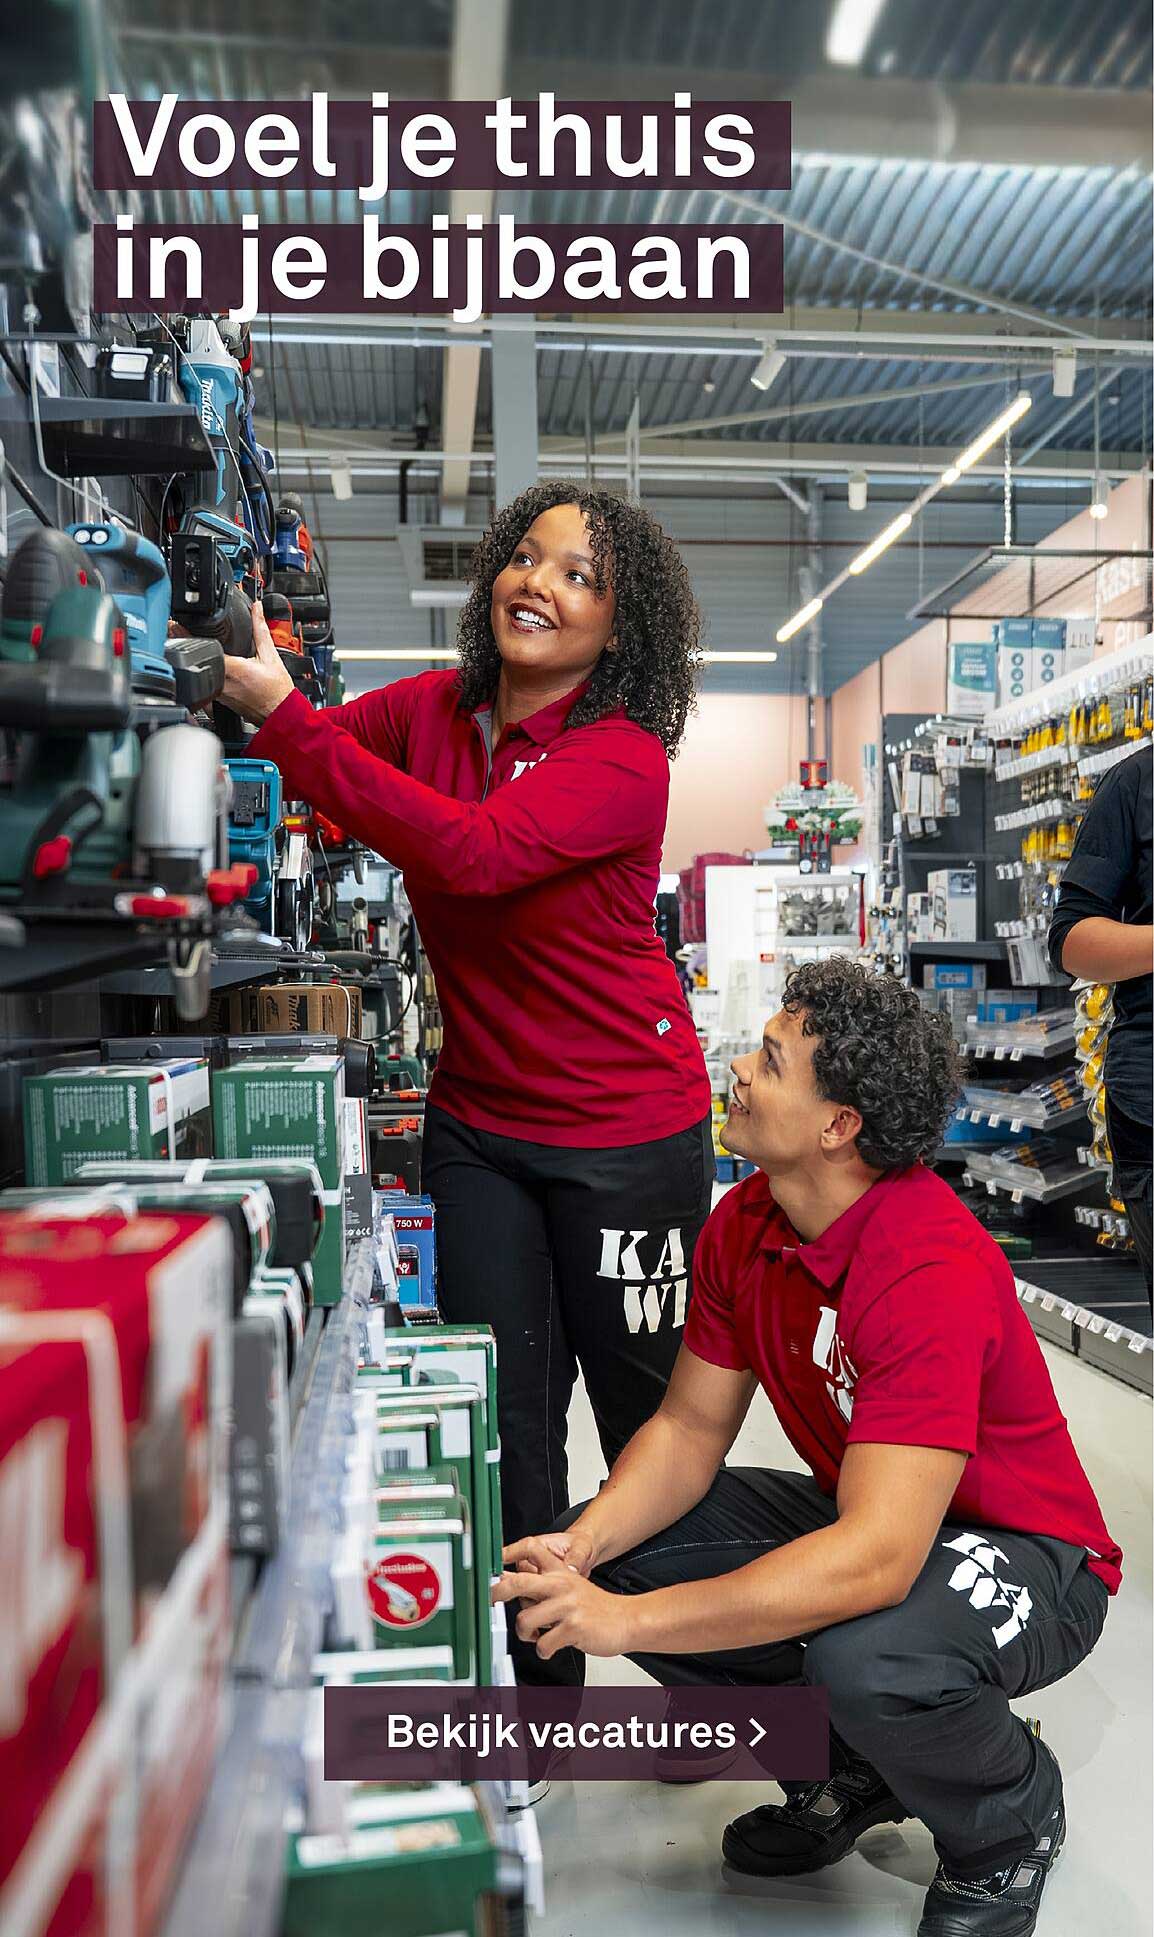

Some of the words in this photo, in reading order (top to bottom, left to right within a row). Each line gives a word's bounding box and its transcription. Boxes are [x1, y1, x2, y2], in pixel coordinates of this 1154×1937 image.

[395, 1219, 412, 1228] 750
[413, 1219, 424, 1228] W
[595, 1227, 688, 1281] KA
